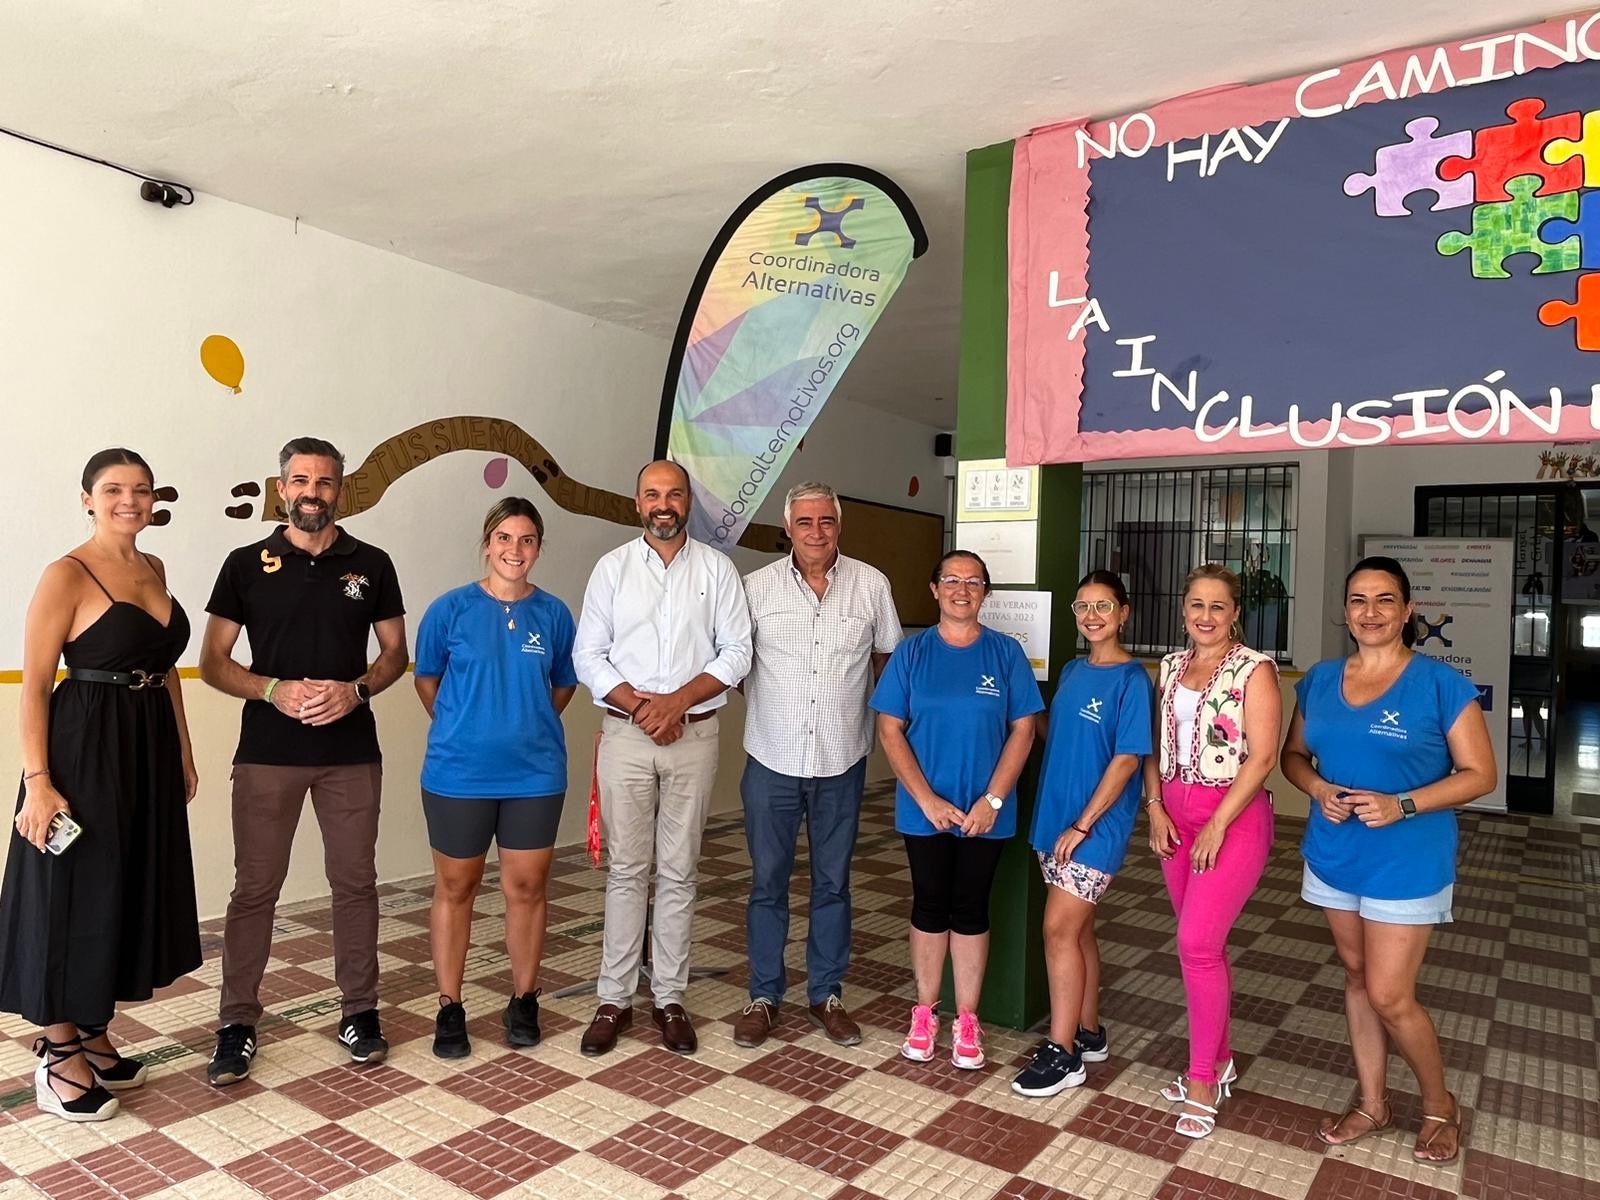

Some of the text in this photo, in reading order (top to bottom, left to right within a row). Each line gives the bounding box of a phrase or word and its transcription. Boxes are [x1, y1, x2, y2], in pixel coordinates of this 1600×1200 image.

[1074, 113, 1155, 168] NO
[1167, 117, 1291, 182] HAY
[741, 271, 877, 307] Alternativas
[749, 252, 881, 282] Coordinadora
[1049, 271, 1110, 341] LA
[1113, 336, 1562, 447] INCLUSIÓN
[369, 432, 431, 477] TUS
[432, 418, 538, 466] SUEÑOS
[708, 322, 860, 545] nadoraalternativas.org
[979, 611, 1035, 622] ATIVAS 2023
[990, 600, 1001, 609] DE
[1003, 600, 1038, 610] VERANO
